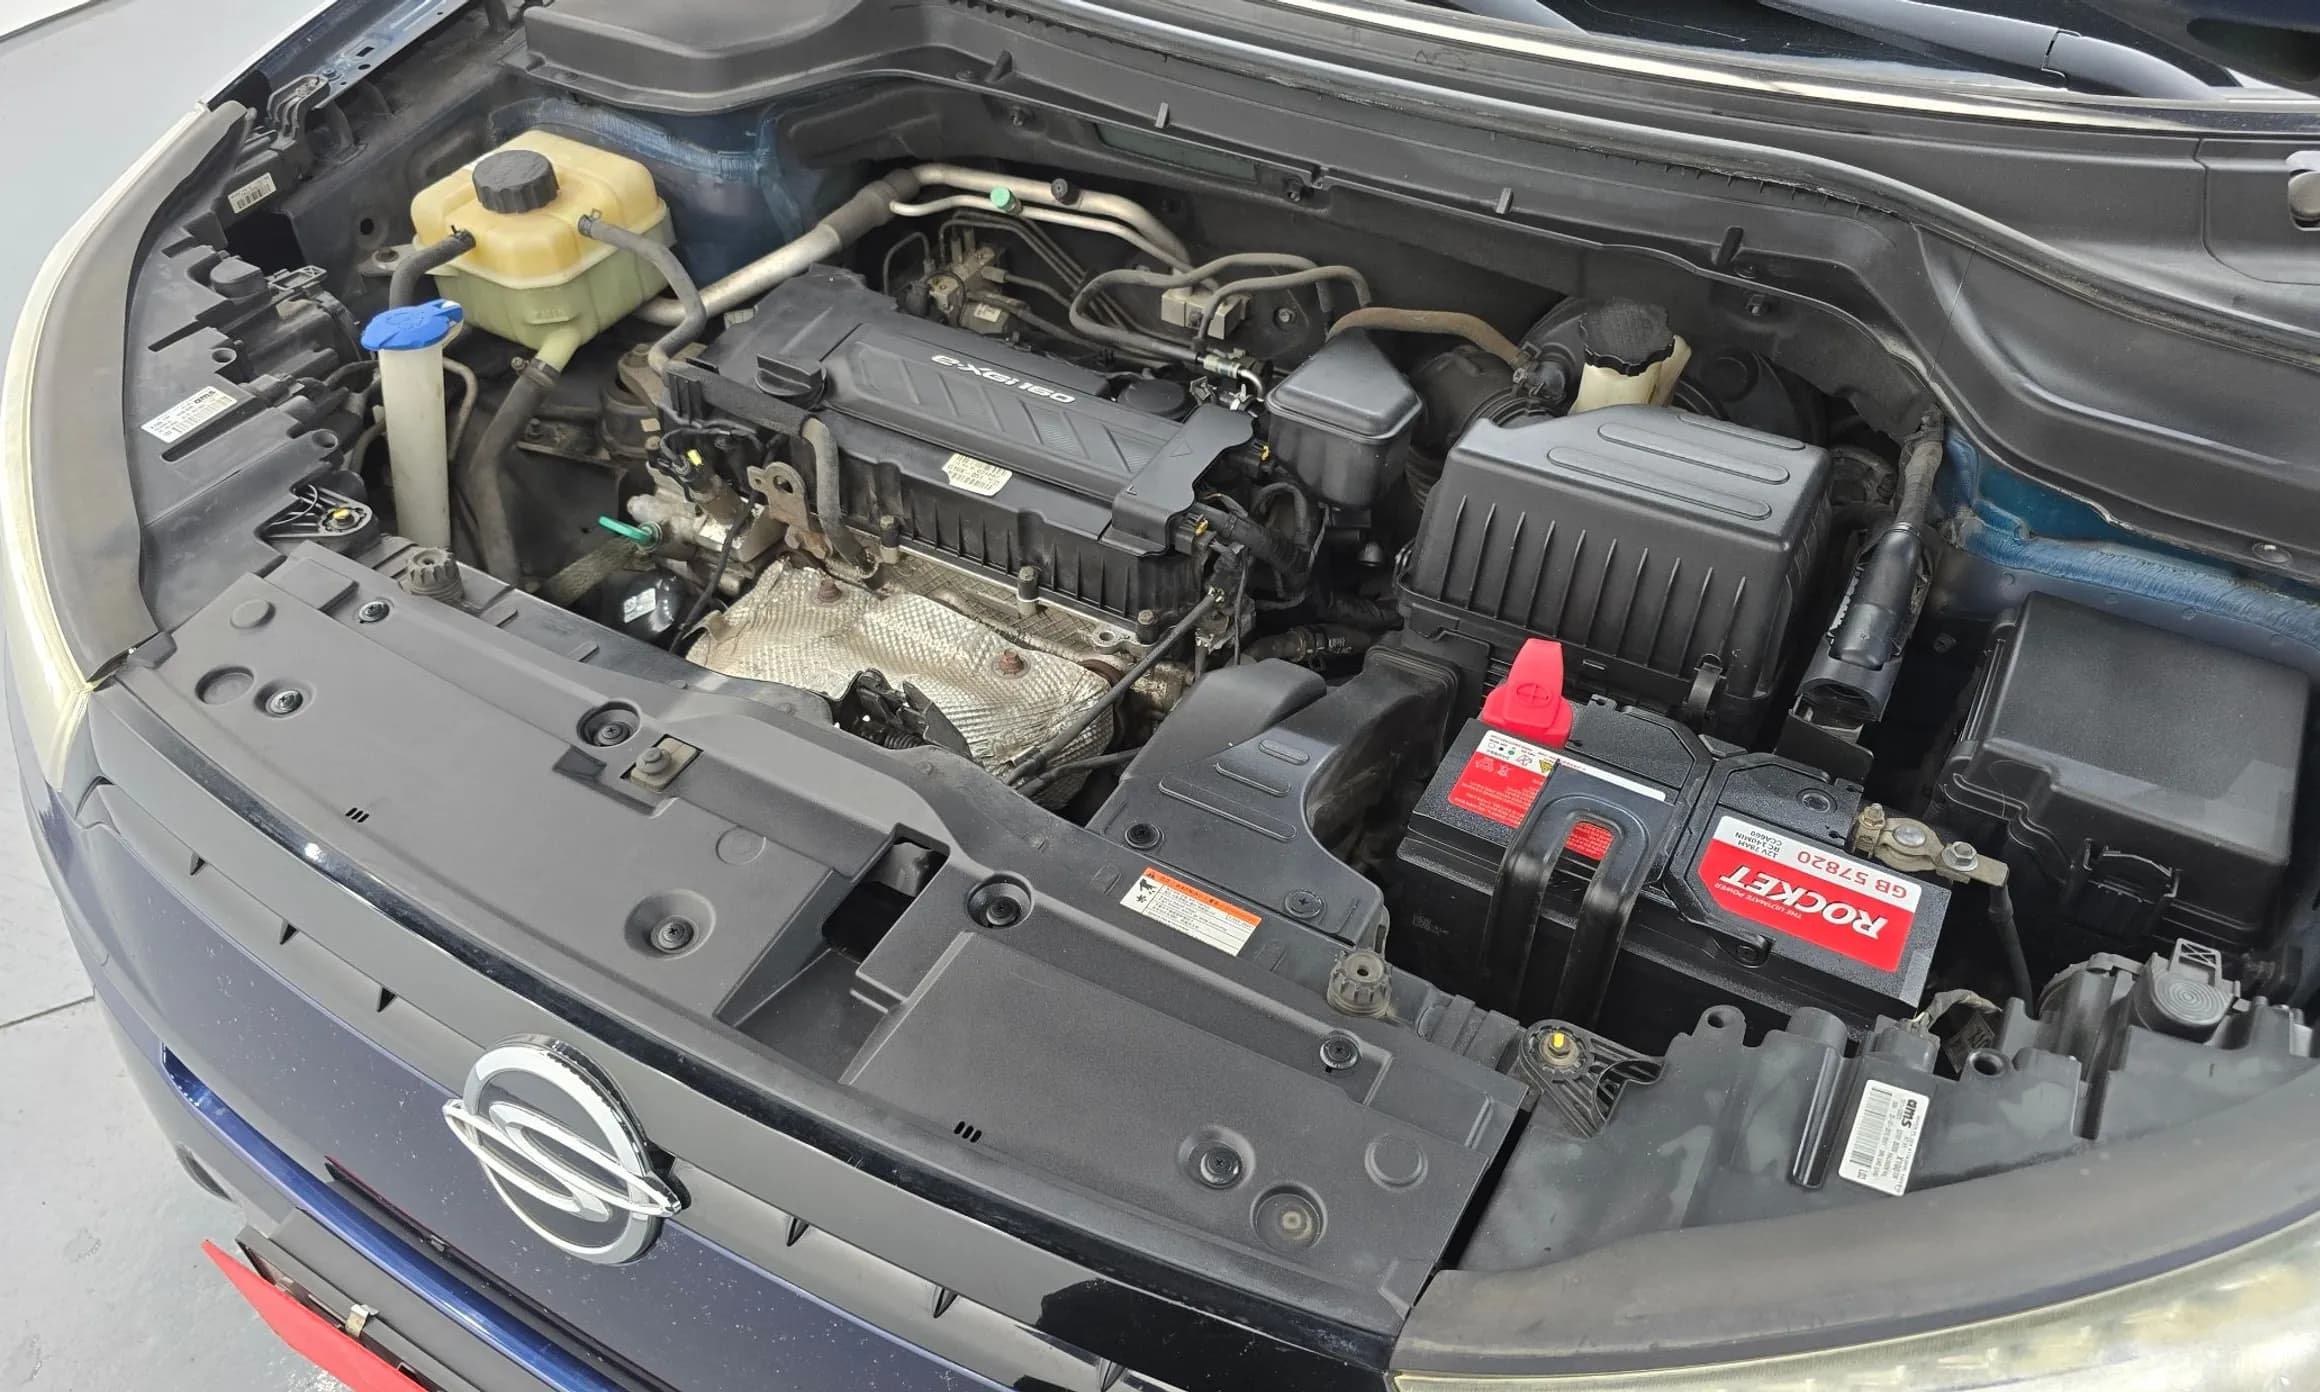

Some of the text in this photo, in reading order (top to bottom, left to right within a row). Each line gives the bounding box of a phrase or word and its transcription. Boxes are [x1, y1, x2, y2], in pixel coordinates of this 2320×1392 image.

[1018, 382, 1076, 403] 160
[1750, 830, 1783, 847] CCA660
[1761, 848, 1779, 859] 12V
[1797, 850, 1908, 899] GB 57820
[1714, 882, 1803, 919] THE ULTIMATE POWER
[1718, 864, 1889, 940] ROCKET
[1901, 1098, 1918, 1129] ams
